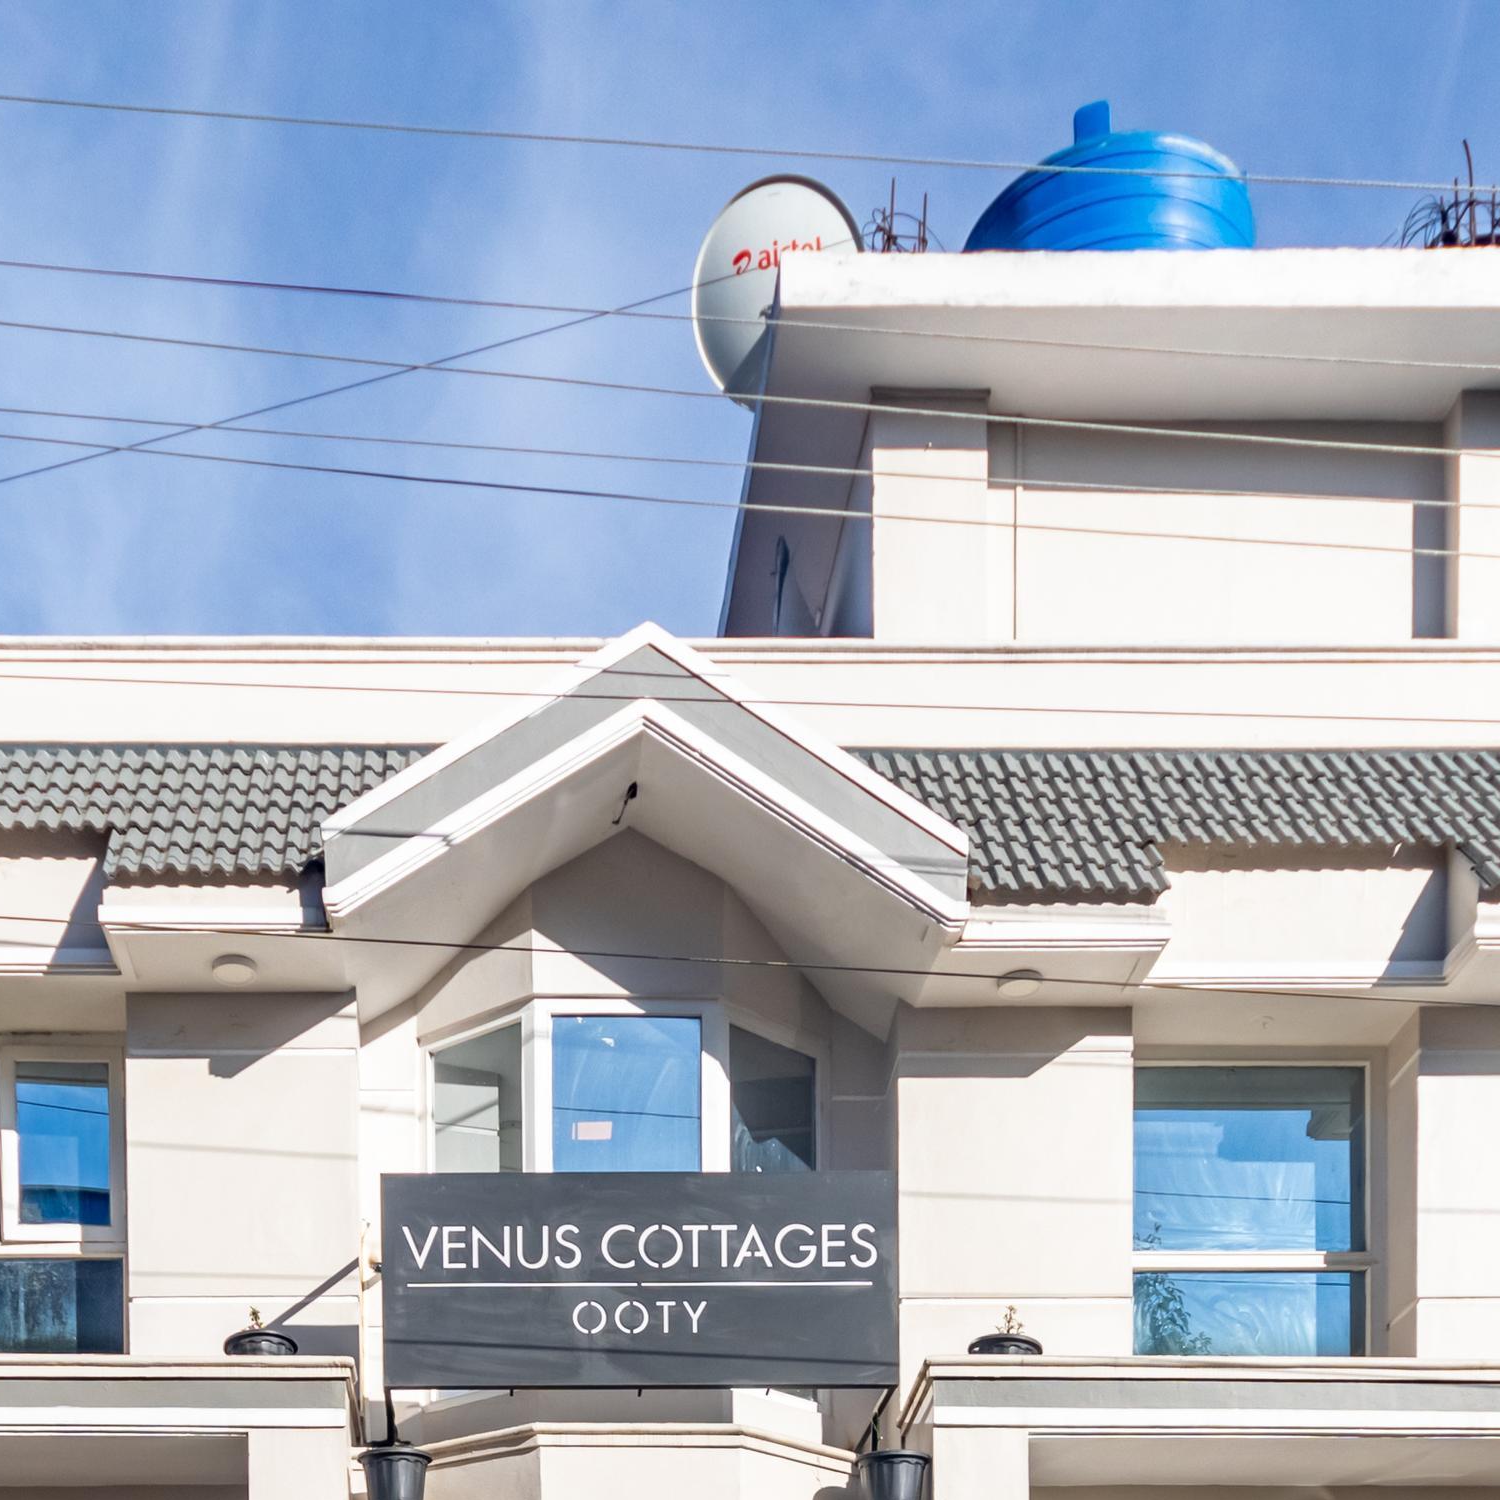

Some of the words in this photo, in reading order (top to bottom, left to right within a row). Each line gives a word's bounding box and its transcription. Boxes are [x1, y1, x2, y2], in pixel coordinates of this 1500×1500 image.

[758, 235, 821, 271] ail
[402, 1225, 581, 1269] VENUS
[601, 1223, 877, 1268] COTTAGES
[573, 1301, 707, 1334] OOTY
